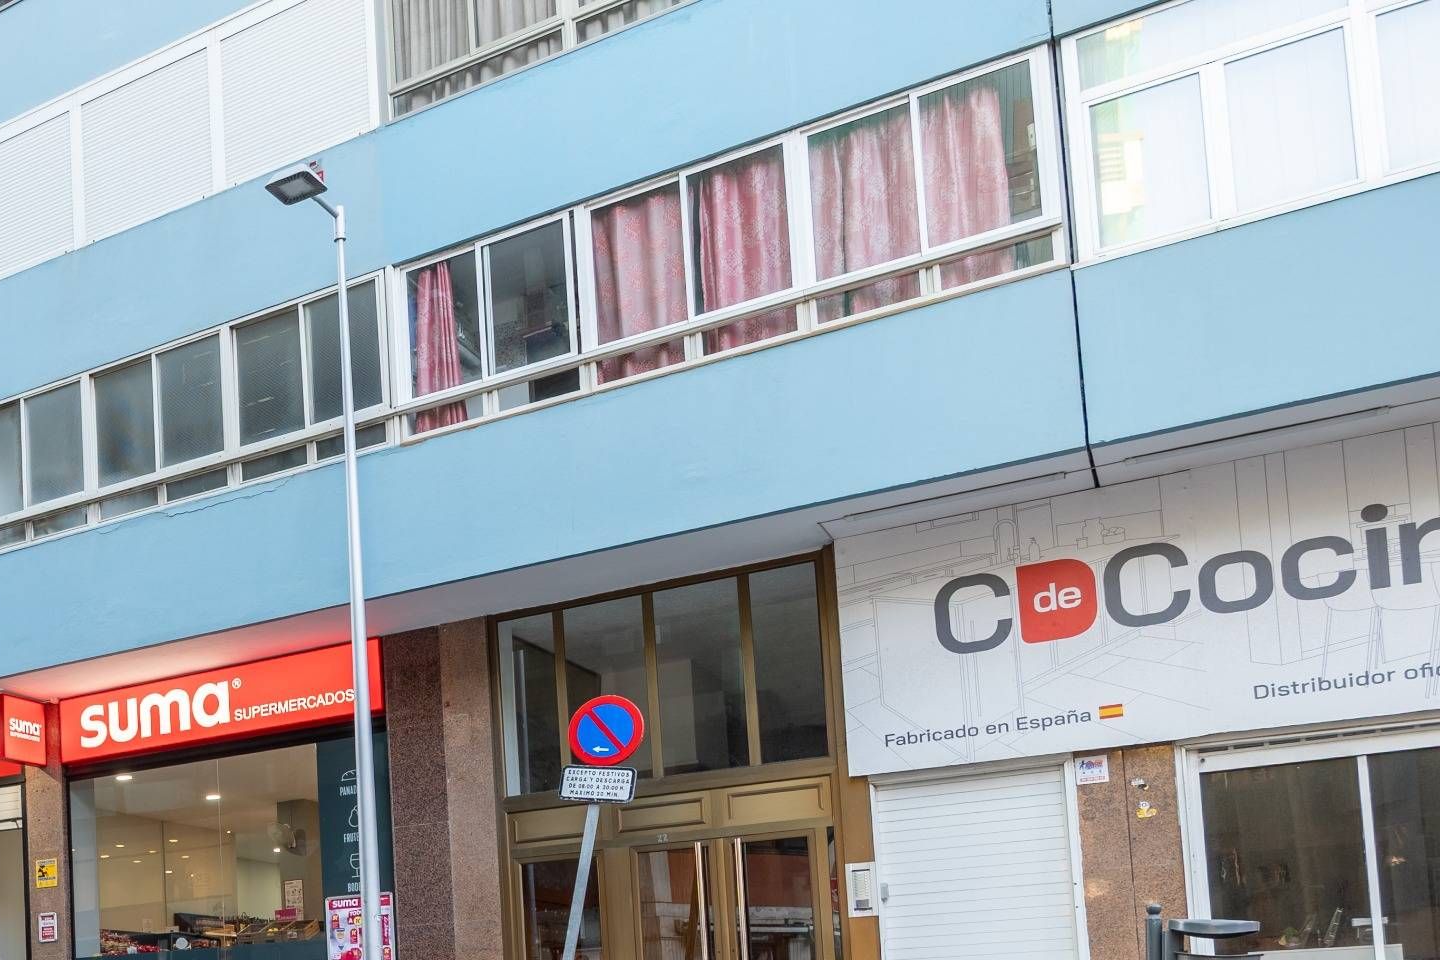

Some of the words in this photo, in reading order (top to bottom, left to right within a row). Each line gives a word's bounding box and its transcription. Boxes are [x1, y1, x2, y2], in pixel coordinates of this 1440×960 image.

[1032, 582, 1082, 614] de
[1253, 670, 1396, 700] Distribuidor
[233, 689, 356, 722] SUPERMERCADOS
[884, 724, 979, 748] Fabricado
[986, 722, 1010, 735] en
[1016, 709, 1092, 731] España
[598, 770, 630, 778] FESTIVOS
[332, 899, 358, 909] suma
